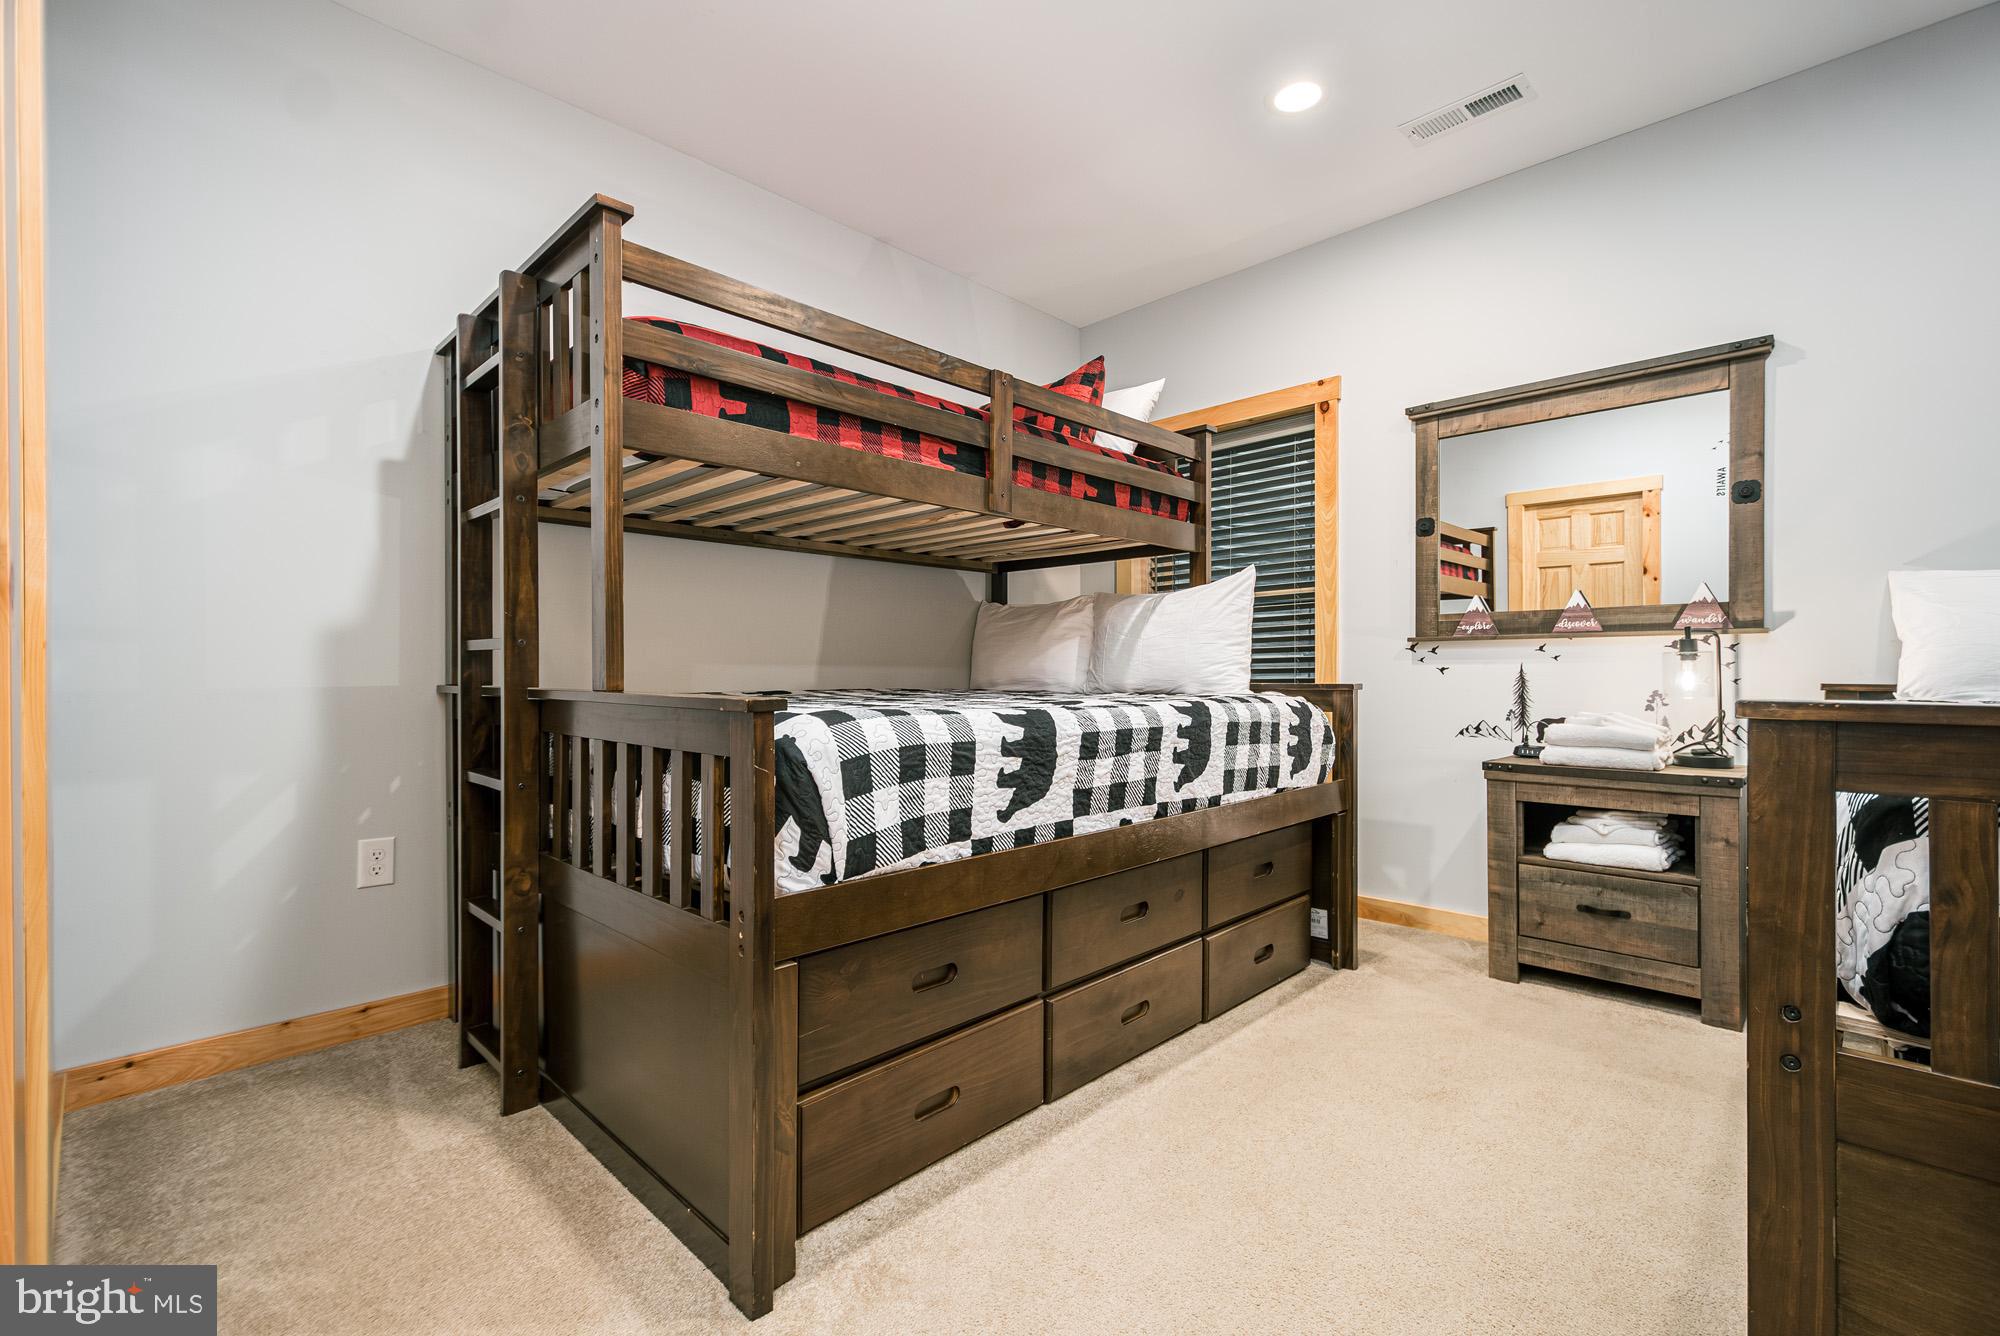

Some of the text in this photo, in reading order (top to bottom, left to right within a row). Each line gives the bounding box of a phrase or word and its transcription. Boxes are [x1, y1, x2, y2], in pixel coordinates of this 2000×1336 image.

[1555, 617, 1598, 630] discover
[1677, 613, 1727, 625] wander
[1457, 621, 1494, 635] explore
